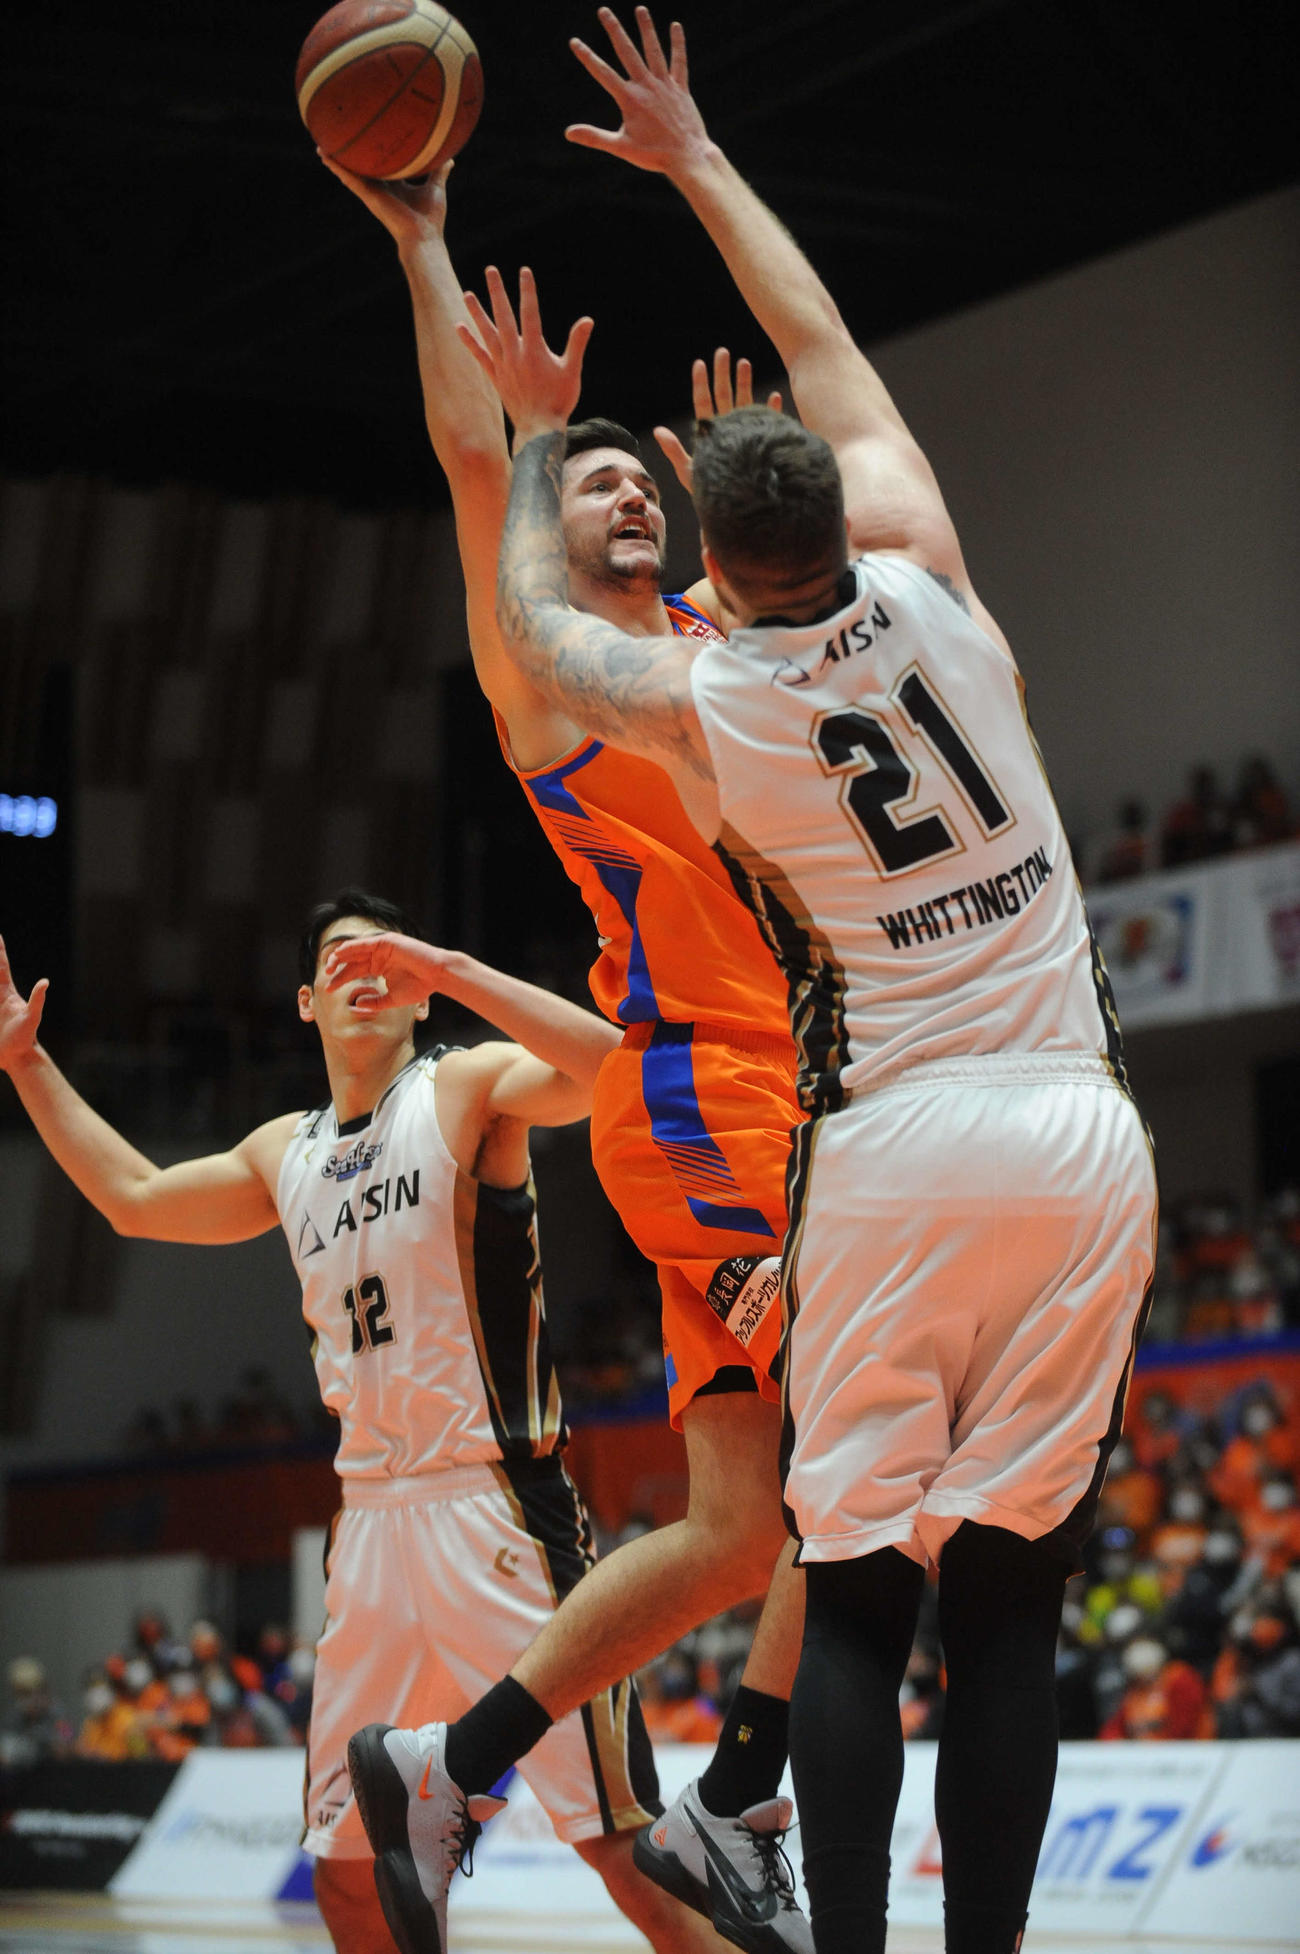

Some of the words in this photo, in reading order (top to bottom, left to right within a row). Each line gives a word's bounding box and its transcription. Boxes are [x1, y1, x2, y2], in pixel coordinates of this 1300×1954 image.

[820, 600, 892, 673] AISN
[807, 659, 1018, 883] 21
[876, 845, 1054, 950] WHITTINGTON
[341, 1269, 398, 1358] 12
